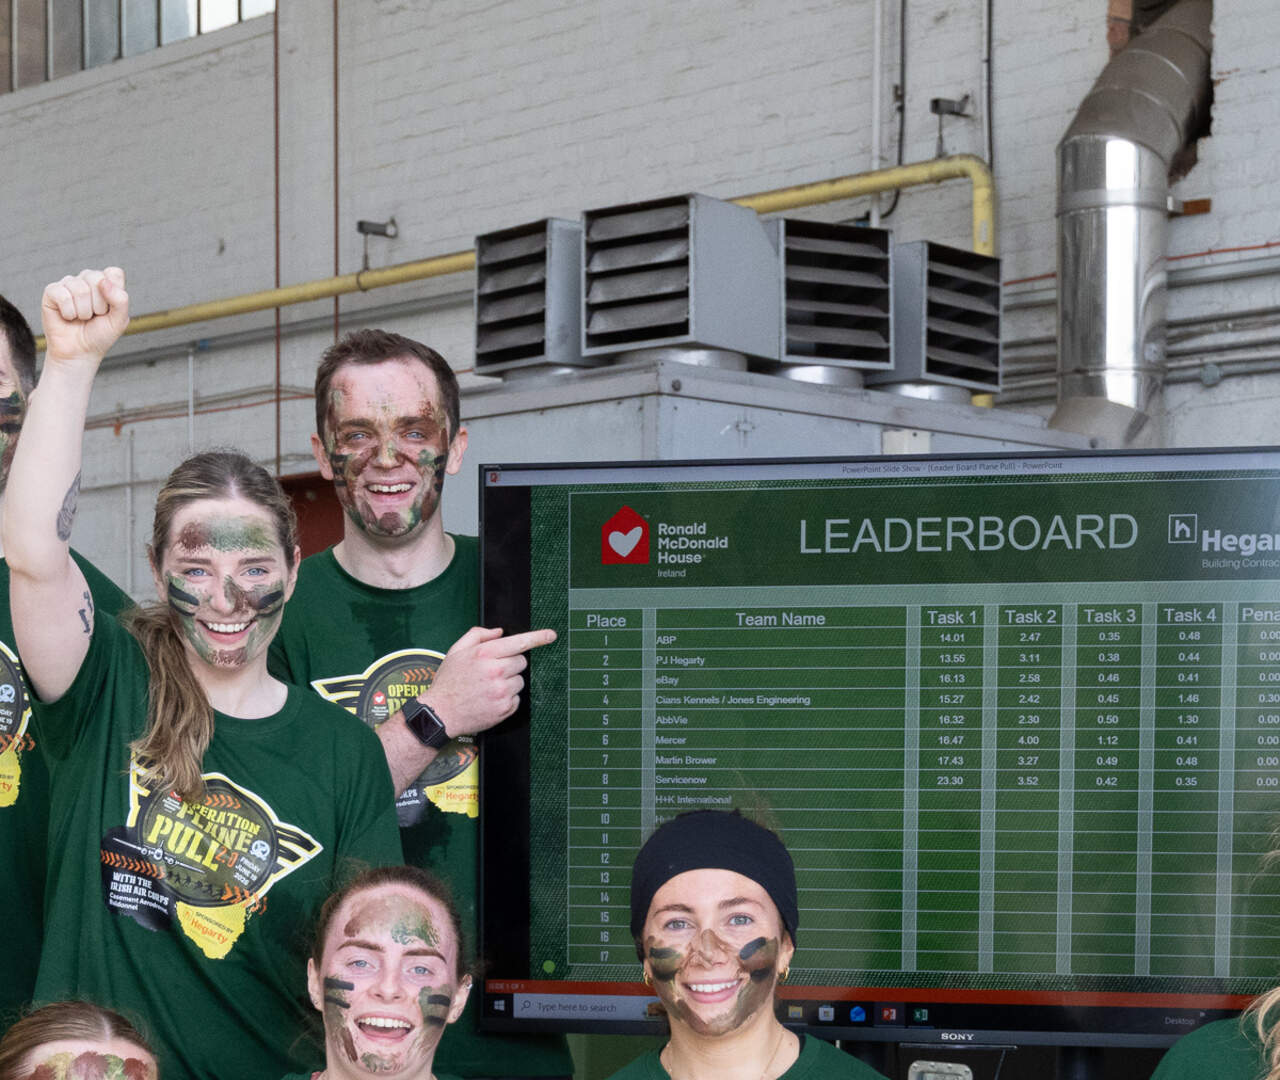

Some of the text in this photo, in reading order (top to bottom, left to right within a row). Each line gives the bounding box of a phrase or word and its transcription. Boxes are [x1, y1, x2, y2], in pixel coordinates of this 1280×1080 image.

[842, 465, 881, 474] PowerPoint
[883, 464, 901, 473] Slide
[902, 464, 921, 473] Show
[1022, 460, 1063, 470] PowerPoint
[657, 522, 706, 536] Ronald
[799, 514, 1138, 554] LEADERBOARD
[657, 535, 728, 550] McDonald
[657, 551, 702, 564] House
[1202, 557, 1239, 570] Building
[657, 568, 686, 577] Ireland
[586, 614, 626, 628] Place
[735, 612, 777, 626] Team
[782, 612, 825, 626] Name
[927, 610, 964, 624] Task
[969, 610, 977, 624] 1
[1005, 609, 1041, 624] Task
[1046, 609, 1057, 623] 2
[1083, 608, 1121, 623] Task
[1125, 609, 1137, 623] 3
[1164, 607, 1201, 622] Task
[1206, 608, 1217, 622] 4
[656, 635, 677, 645] ABP
[939, 633, 965, 643] 14.01
[1019, 632, 1041, 642] 2.47
[1099, 632, 1121, 642] 0.35
[1178, 631, 1201, 641] 0.48
[670, 655, 705, 667] Hegarty
[939, 654, 965, 664] 13.55
[1019, 653, 1041, 663] 3.11
[1098, 652, 1120, 662] 0.38
[1178, 652, 1200, 662] 0.44
[656, 675, 679, 687] eBay
[938, 674, 965, 684] 16.13
[1019, 673, 1041, 683] 2.58
[1098, 673, 1120, 683] 0.46
[1177, 672, 1200, 682] 0.41
[1259, 672, 1280, 682] 0.00
[656, 695, 682, 705] Cians
[683, 695, 720, 705] Kennels
[727, 695, 754, 705] Jones
[756, 695, 811, 707] Engineering
[938, 694, 965, 704] 15.27
[1018, 694, 1040, 704] 2.42
[1097, 694, 1119, 704] 0.45
[1177, 693, 1200, 703] 1.46
[1258, 693, 1280, 703] 0.30
[656, 715, 688, 725] AbbVie
[938, 715, 964, 725] 16.32
[1018, 715, 1040, 725] 2.30
[1097, 715, 1119, 725] 0.50
[1177, 714, 1199, 724] 1.30
[1258, 714, 1280, 724] 0.00
[656, 735, 687, 745] Mercer
[937, 735, 964, 745] 16.47
[1018, 735, 1040, 745] 4.00
[1097, 735, 1119, 745] 1.12
[1176, 736, 1199, 746] 0.41
[1257, 735, 1280, 745] 0.00
[656, 755, 1279, 766] Martin Brower 17.43 3.27 0.49 0.48 0.00
[656, 775, 1279, 787] Servicenow 23.30 3.52 0.42 0.35 0.00
[677, 795, 732, 805] International
[147, 813, 220, 872] PULL
[215, 846, 238, 868] 2.0
[190, 918, 228, 944] Hegarty
[537, 1002, 557, 1012] Type
[558, 1002, 578, 1011] here
[590, 1003, 616, 1012] search
[1164, 1016, 1195, 1026] Desktop
[941, 1032, 974, 1041] SONY
